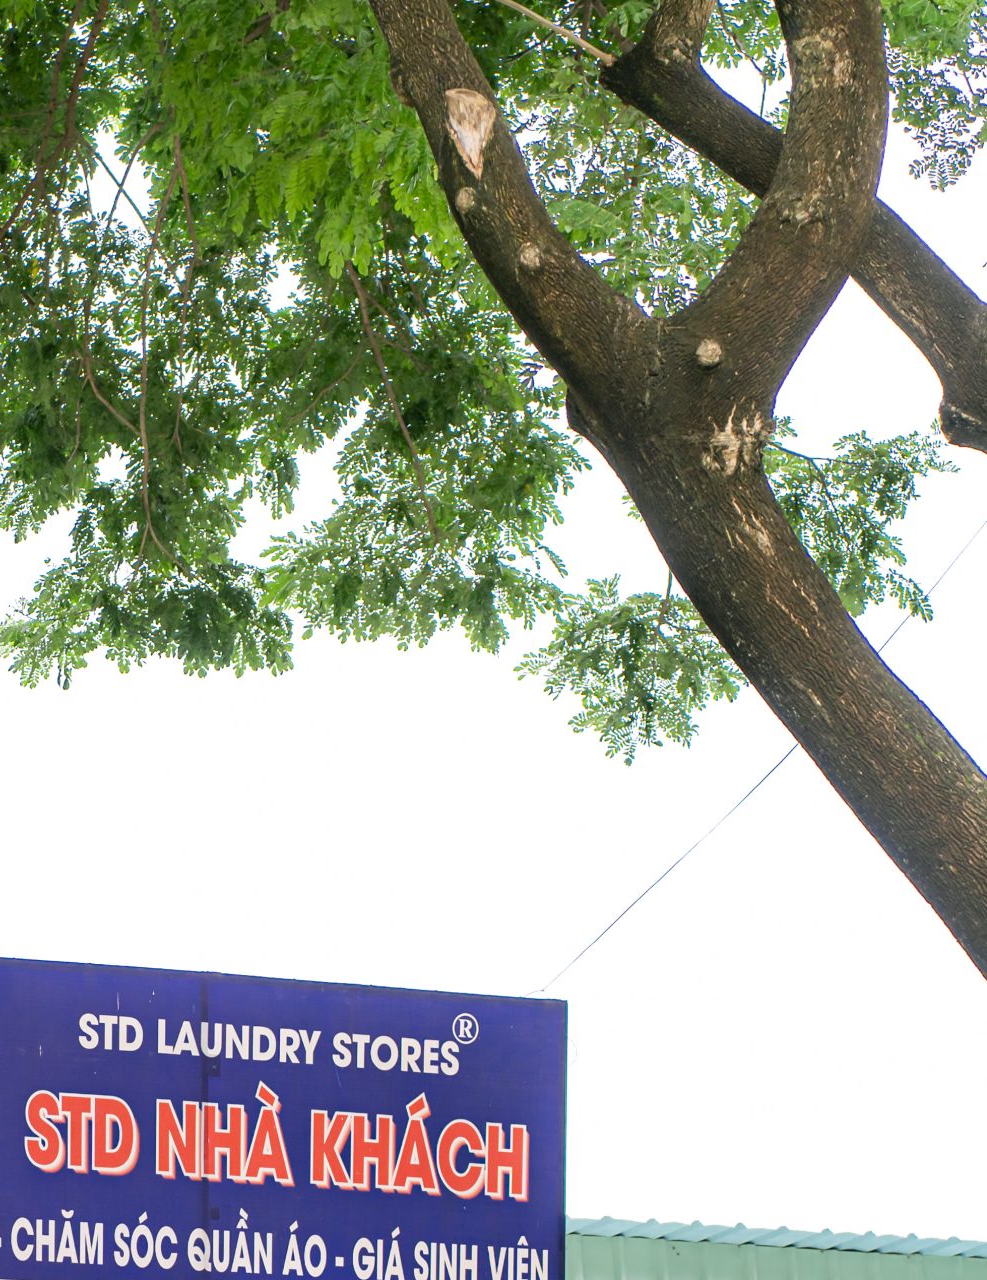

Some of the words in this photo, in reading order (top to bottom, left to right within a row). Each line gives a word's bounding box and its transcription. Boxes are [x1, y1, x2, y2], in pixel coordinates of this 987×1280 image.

[79, 1013, 143, 1051] STD
[158, 1019, 321, 1064] LAUNDRY
[332, 1029, 463, 1075] STORES
[24, 1089, 141, 1176] STD
[155, 1080, 296, 1187] NHÀ
[310, 1091, 531, 1202] KHÁCH
[11, 1209, 103, 1265] CHĂM
[114, 1211, 177, 1269] SÓC
[188, 1208, 272, 1274] QUẦN
[283, 1221, 327, 1277] ÁO
[353, 1227, 405, 1280] GIÁ
